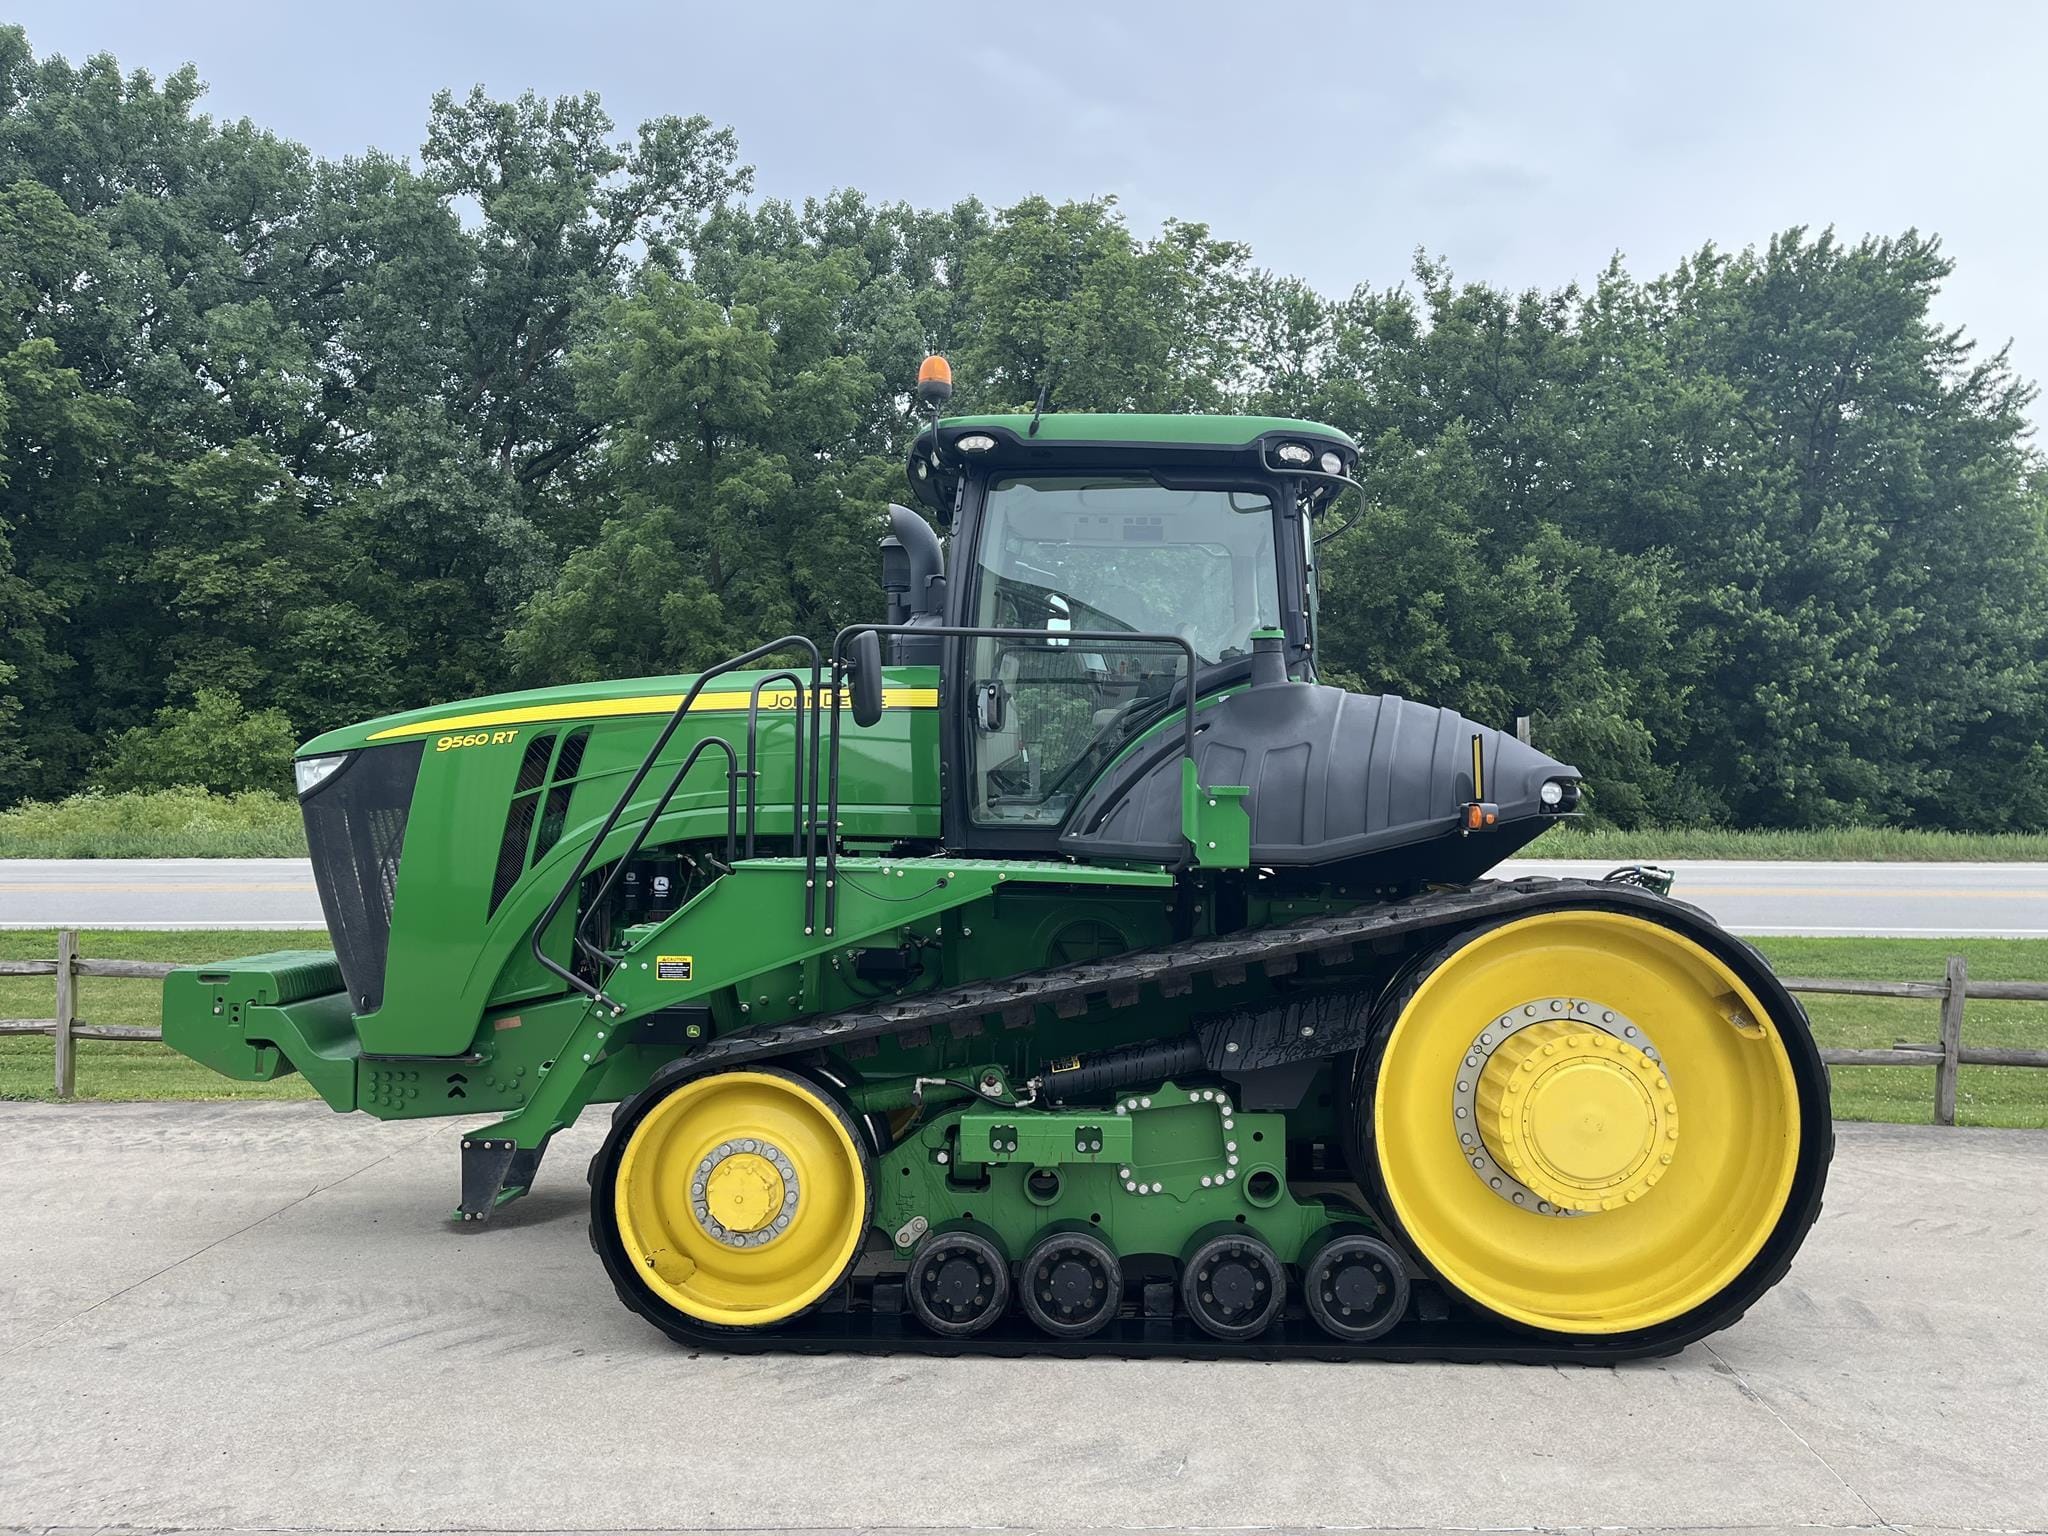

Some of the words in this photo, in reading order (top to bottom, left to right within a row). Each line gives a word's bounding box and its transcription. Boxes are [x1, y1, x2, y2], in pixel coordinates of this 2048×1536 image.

[768, 694, 814, 708] JO
[436, 733, 489, 751] 9560
[491, 730, 519, 745] RT
